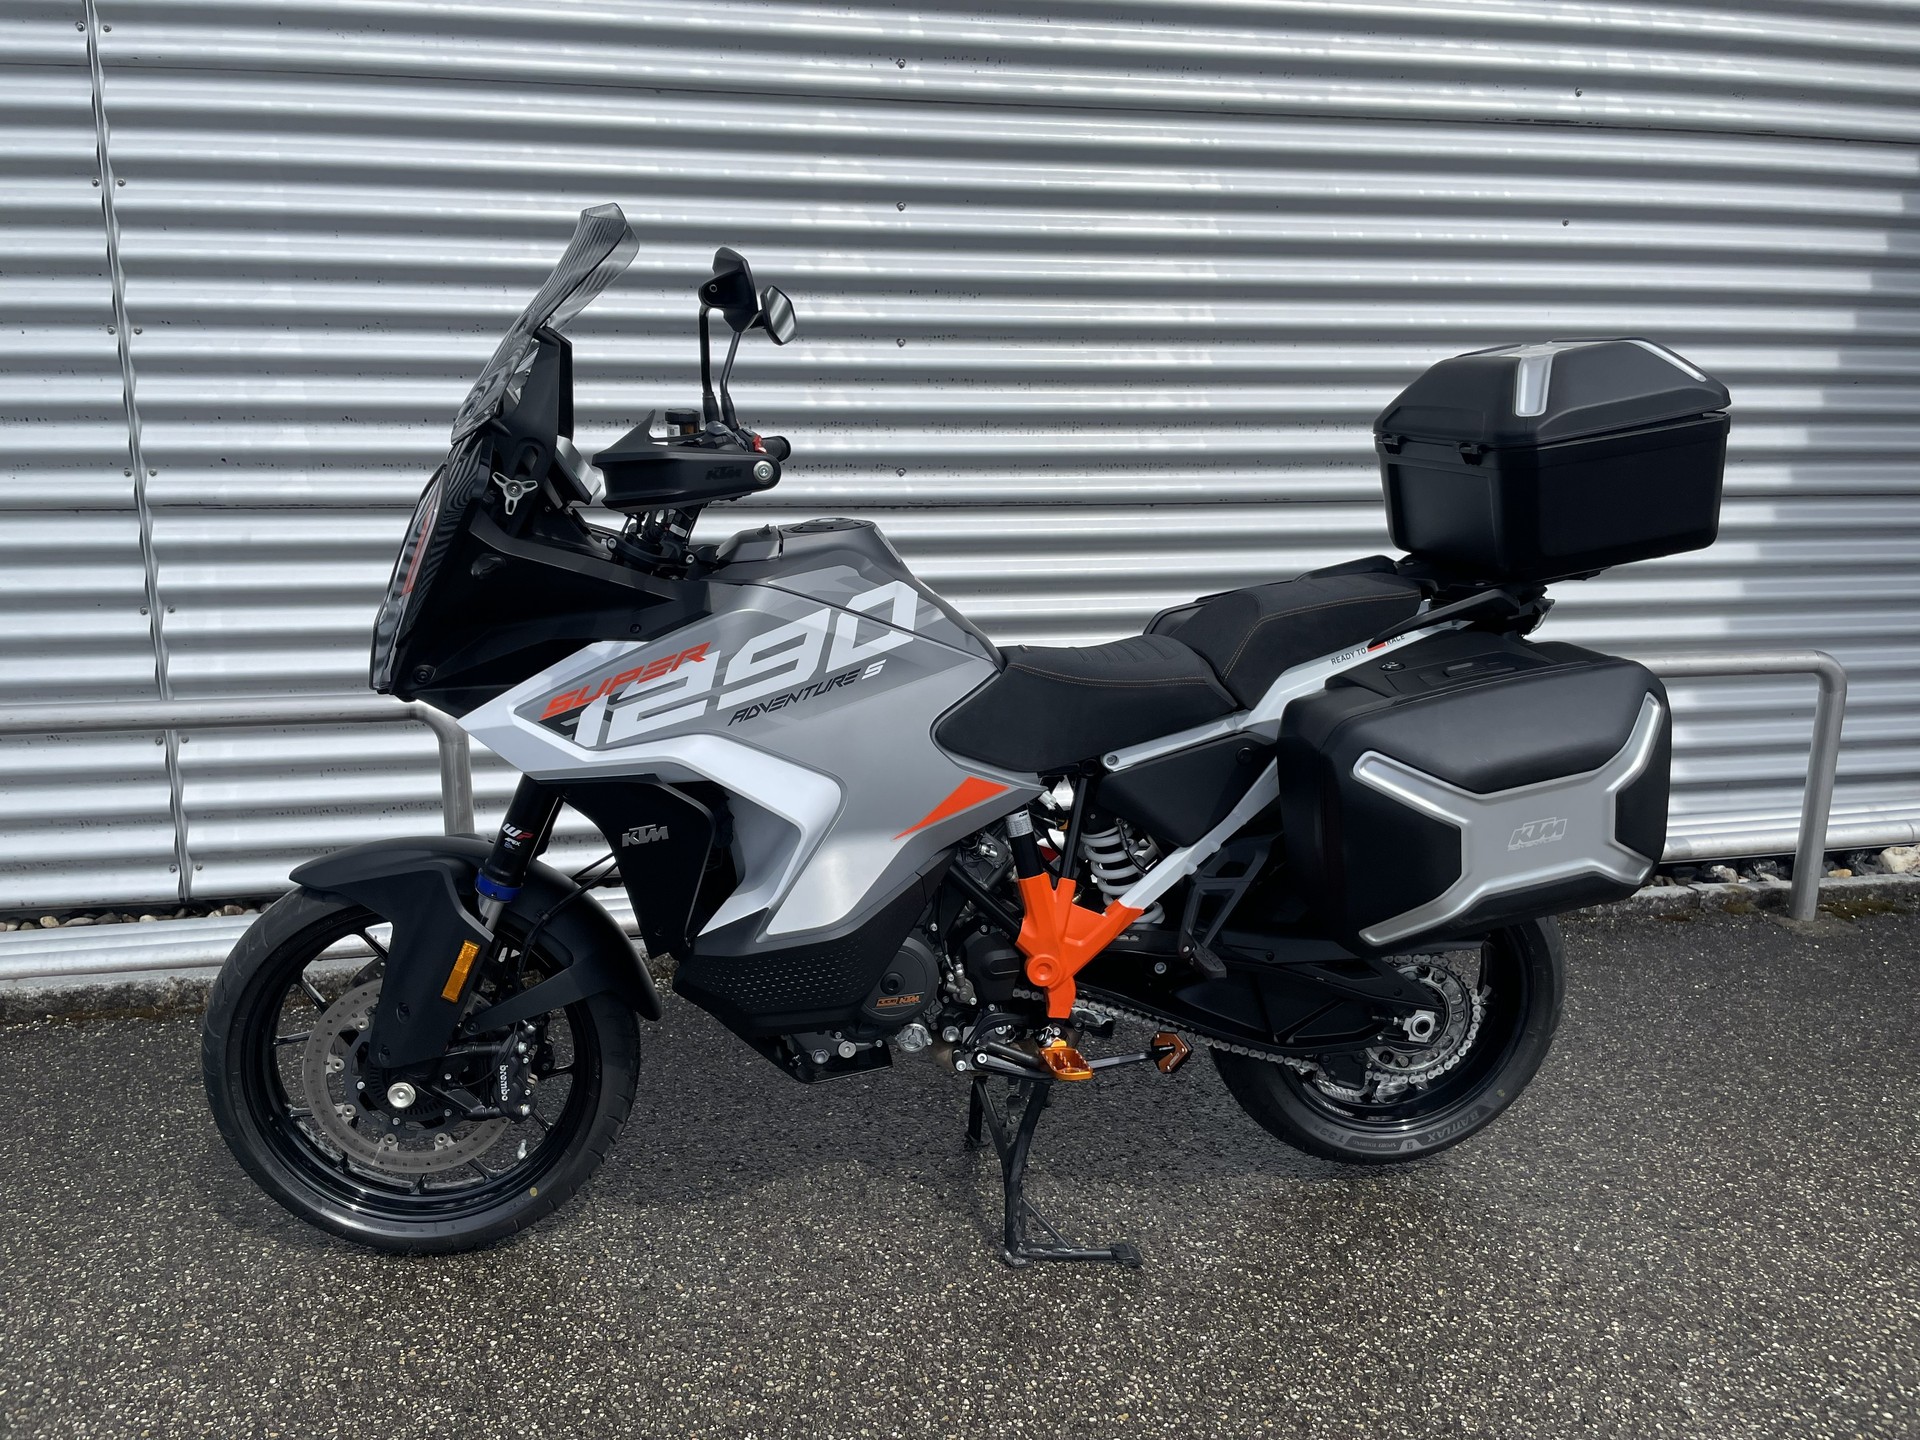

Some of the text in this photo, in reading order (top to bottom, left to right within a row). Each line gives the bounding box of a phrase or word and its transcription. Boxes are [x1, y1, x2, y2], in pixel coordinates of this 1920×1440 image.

[573, 580, 918, 748] 1290
[1330, 650, 1355, 665] READY
[1356, 647, 1367, 656] TO
[539, 641, 711, 721] SUPER
[727, 658, 887, 727] ADVENTURE S
[621, 823, 670, 848] KTM
[1508, 816, 1568, 847] KTM
[499, 1064, 511, 1102] brembo
